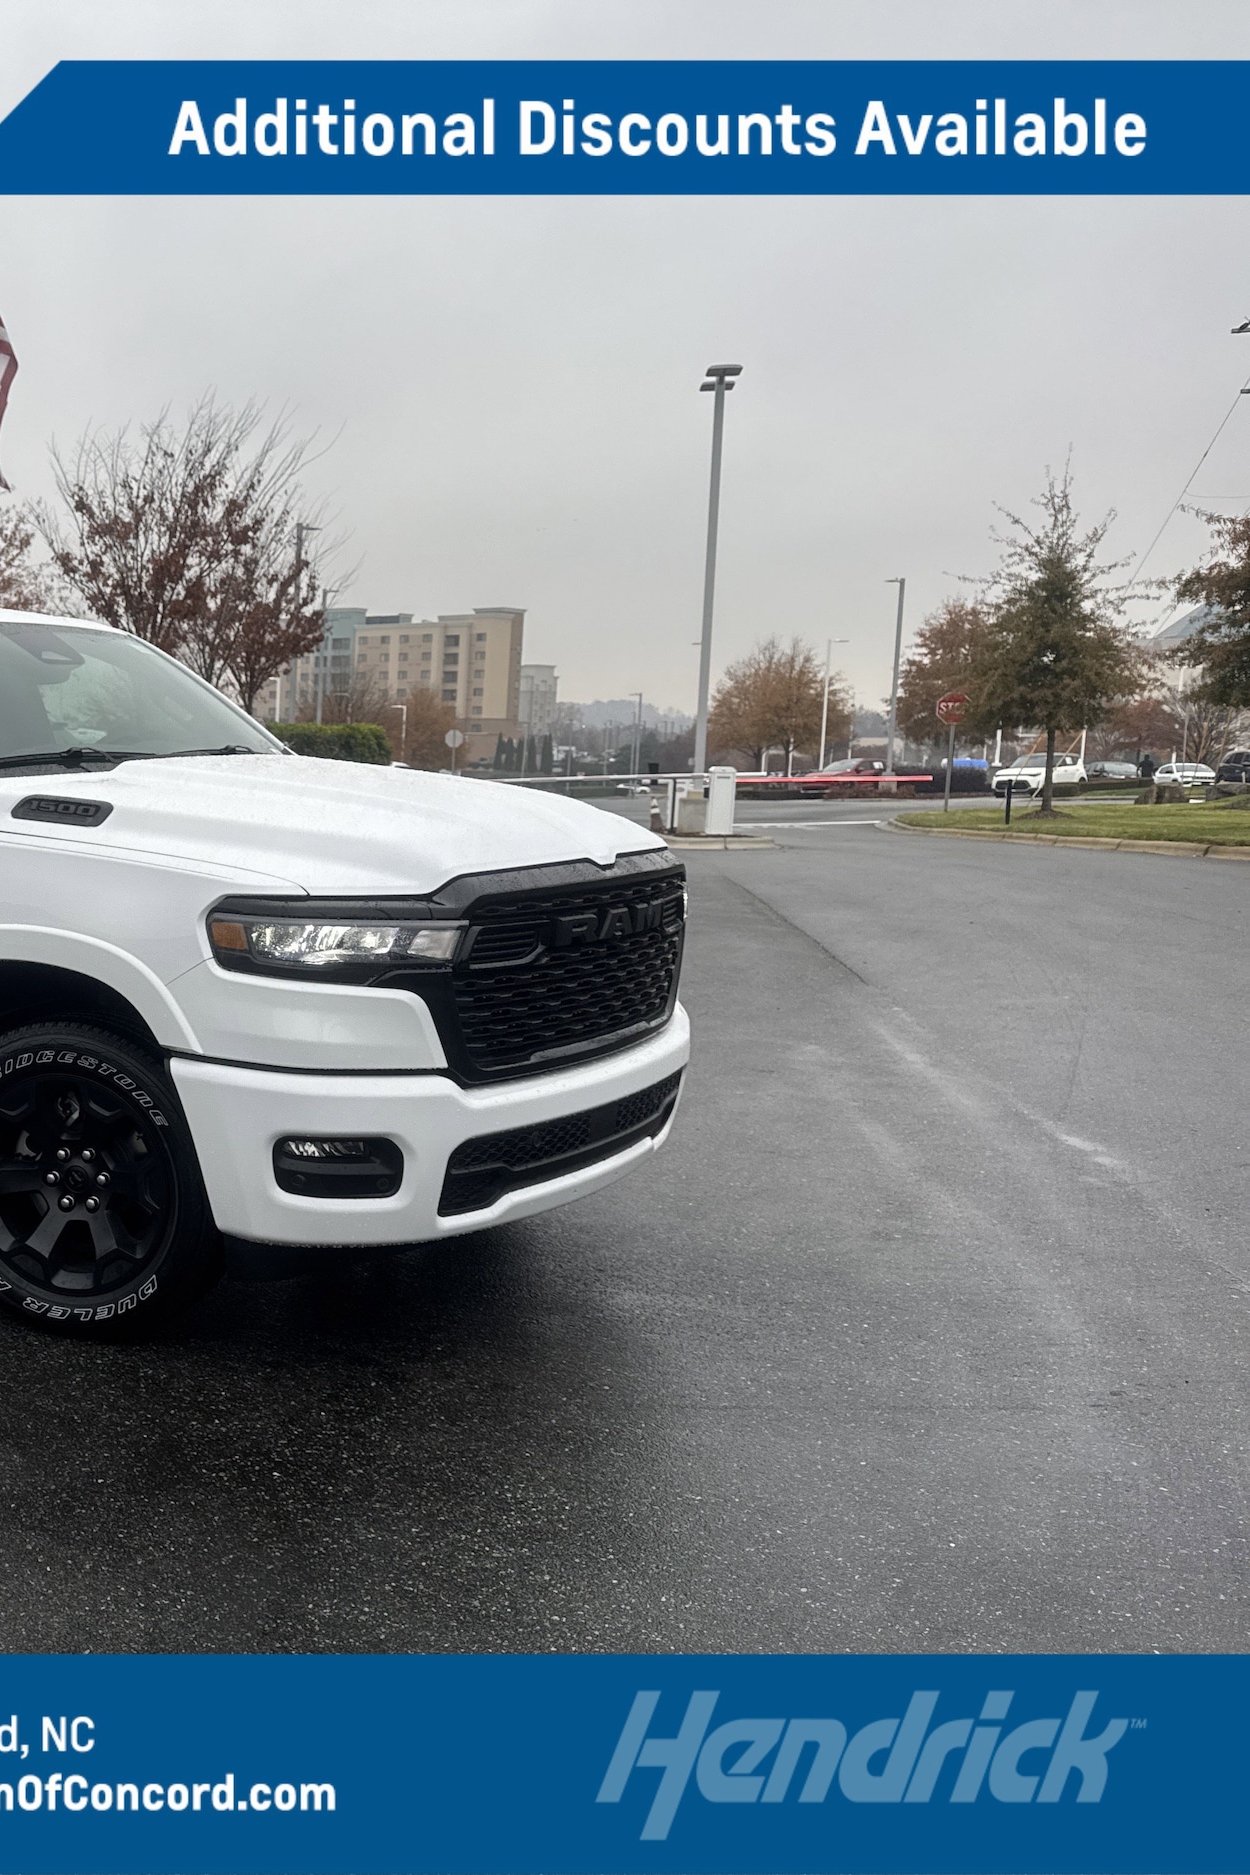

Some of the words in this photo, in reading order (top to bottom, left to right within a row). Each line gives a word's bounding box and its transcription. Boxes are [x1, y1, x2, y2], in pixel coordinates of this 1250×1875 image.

[939, 702, 965, 714] ST
[24, 799, 99, 817] 1500
[557, 900, 664, 947] RAM
[22, 1274, 158, 1321] DUELER
